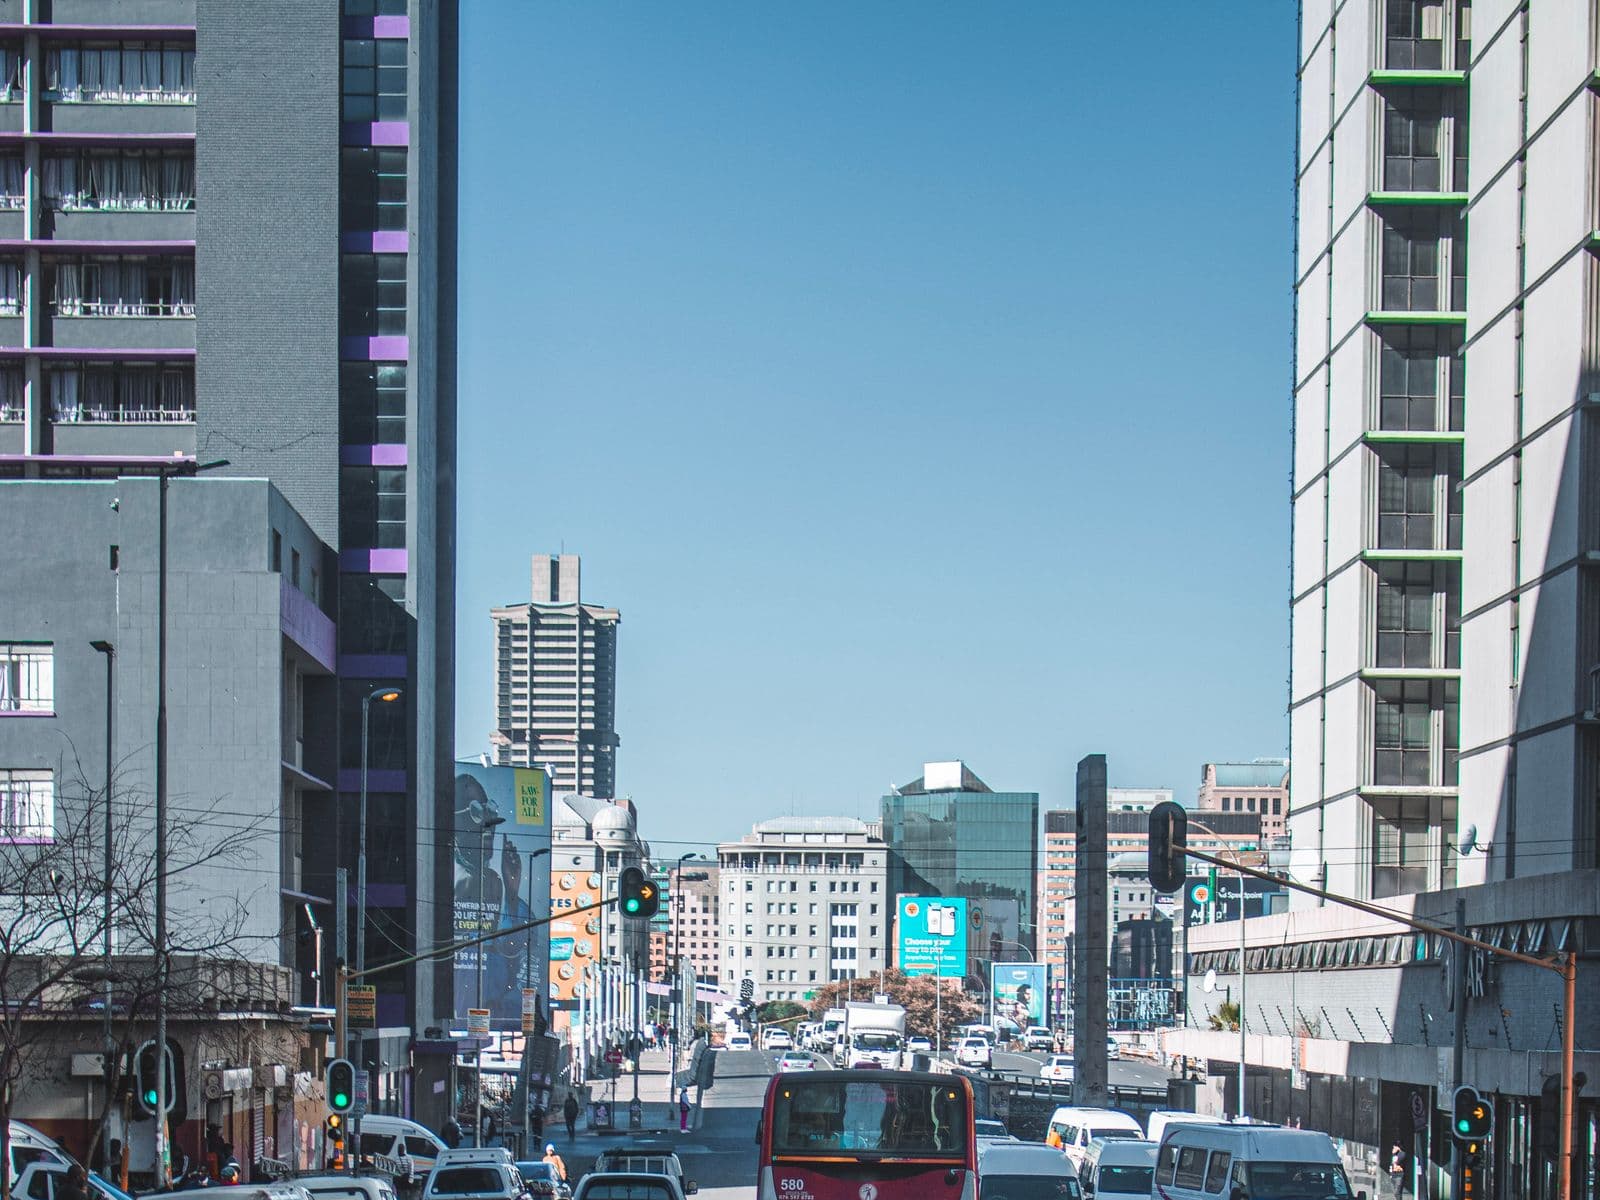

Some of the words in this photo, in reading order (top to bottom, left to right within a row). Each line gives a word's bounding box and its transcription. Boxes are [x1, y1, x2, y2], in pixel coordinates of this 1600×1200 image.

[521, 796, 537, 806] FOR
[486, 903, 499, 912] YOU
[464, 911, 476, 920] LIFE
[781, 1179, 804, 1190] 580
